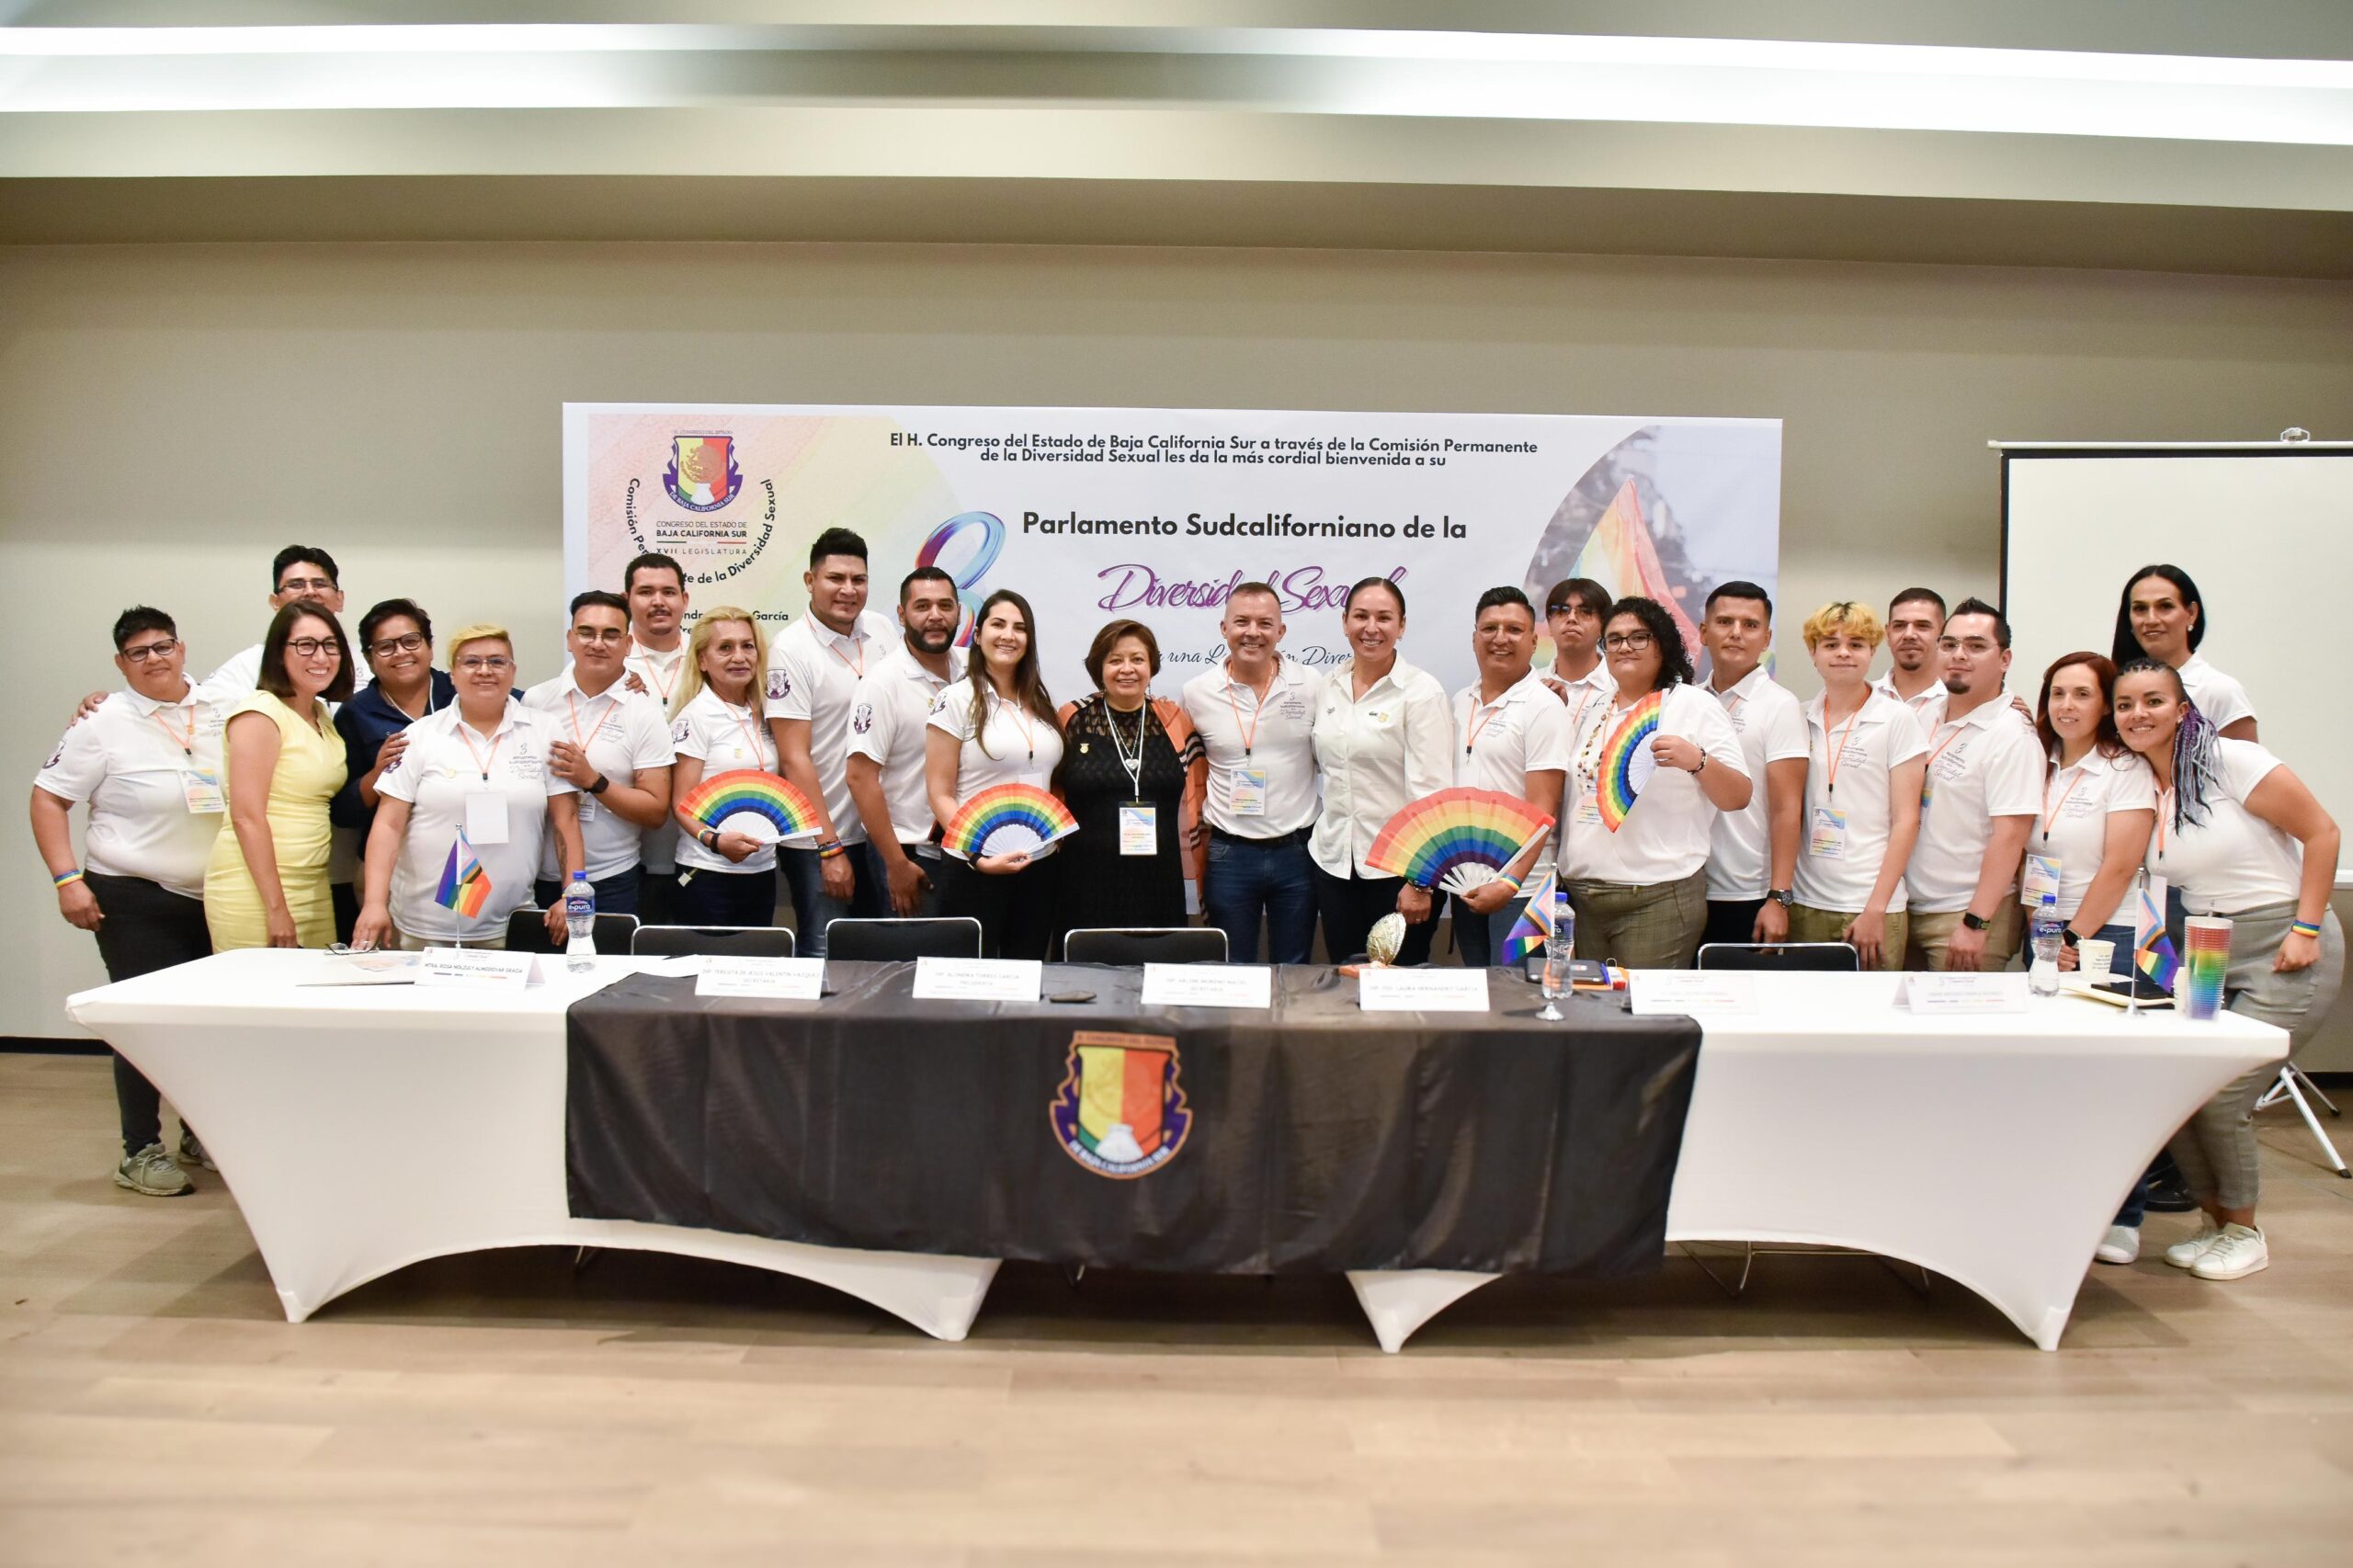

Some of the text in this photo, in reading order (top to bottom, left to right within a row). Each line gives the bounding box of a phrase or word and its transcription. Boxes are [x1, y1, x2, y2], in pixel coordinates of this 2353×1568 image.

[891, 433, 1539, 454] El H. Congreso del Estado de Baja California Sur a través de la Comisión Permanente
[980, 448, 1446, 466] de la Diversidad Sexual les da la más cordial bienvenida a su
[625, 477, 641, 535] Comisión
[697, 572, 712, 584] de
[715, 571, 727, 582] la
[728, 524, 774, 577] Diversidad
[760, 478, 776, 521] Sexual
[656, 520, 694, 528] CONGRESO
[696, 520, 708, 528] DEL
[1023, 511, 1467, 539] Parlamento Sudcaliforniano de la
[656, 529, 747, 538] BAJA CALIFORNIA SUR
[753, 610, 789, 621] García
[1167, 652, 1202, 663] una
